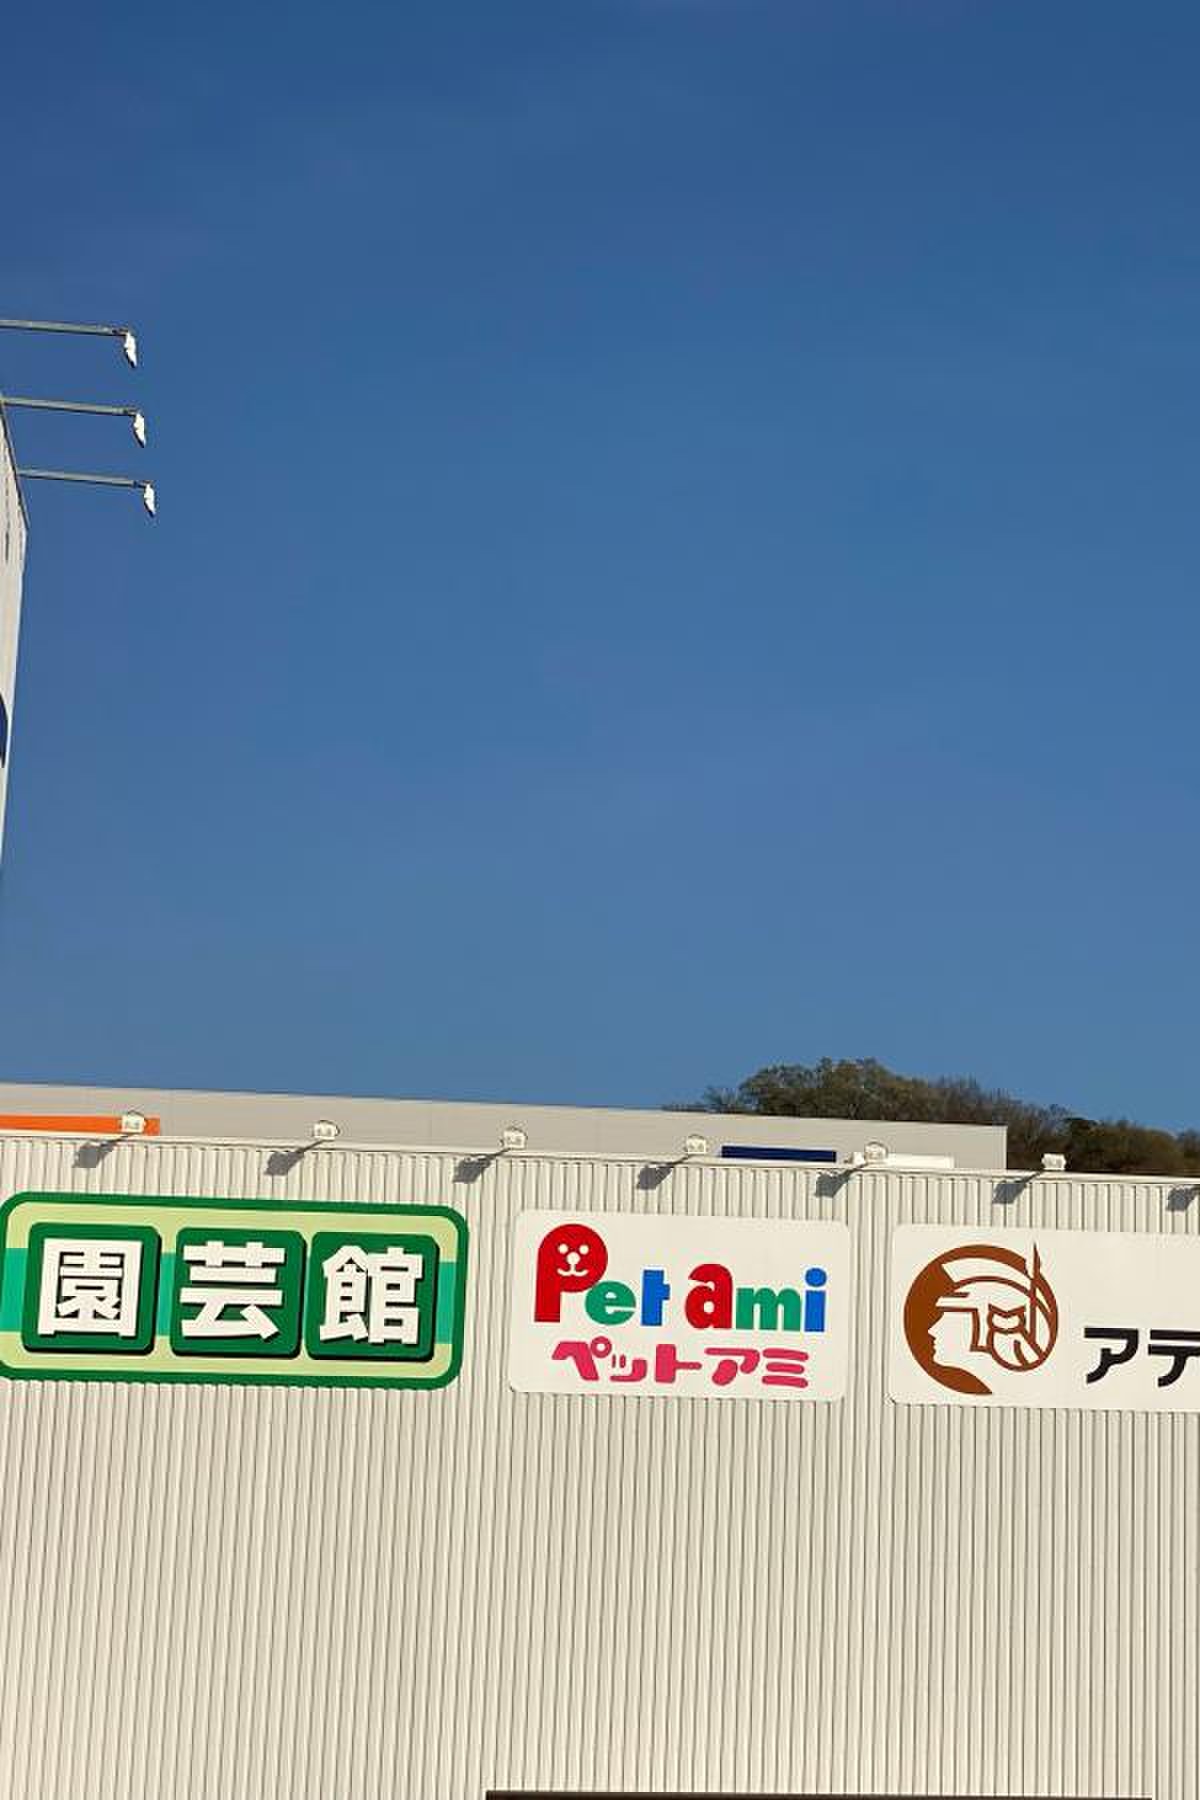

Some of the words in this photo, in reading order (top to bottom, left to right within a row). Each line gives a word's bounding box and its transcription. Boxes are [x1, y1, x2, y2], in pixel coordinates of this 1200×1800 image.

[37, 1238, 425, 1345] 園芸館
[534, 1223, 670, 1327] Pet
[551, 1336, 809, 1389] ペットアミ
